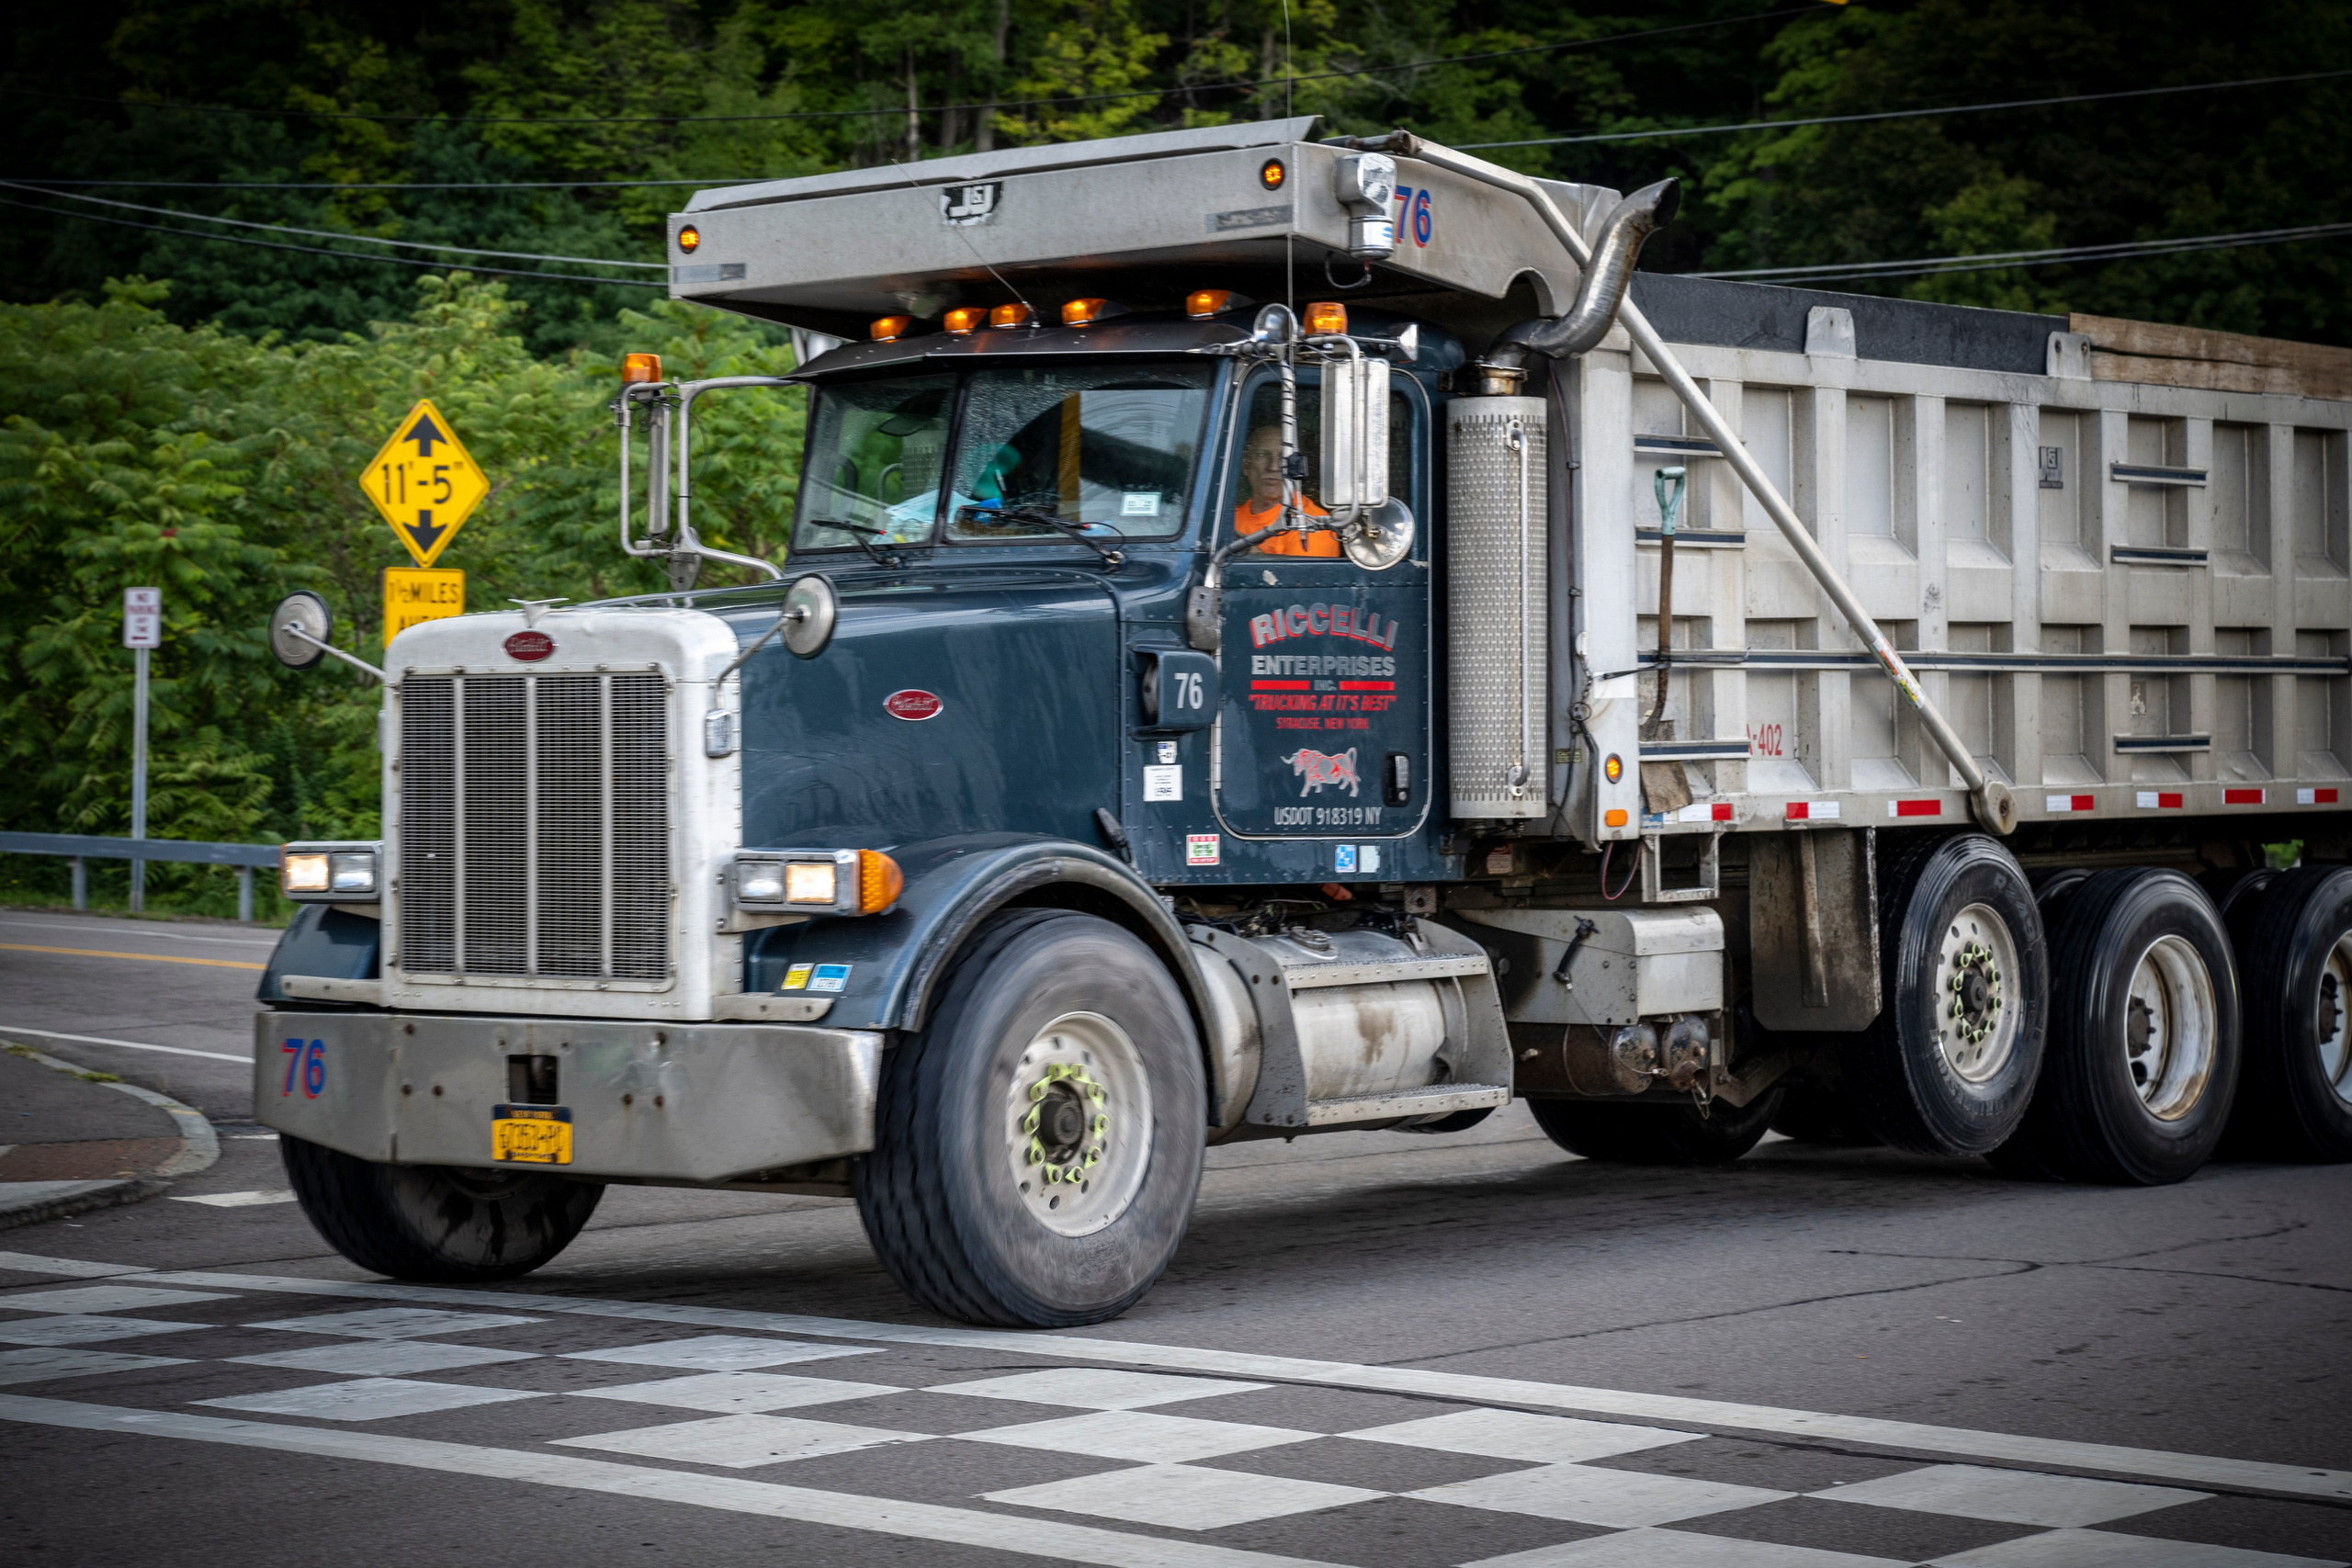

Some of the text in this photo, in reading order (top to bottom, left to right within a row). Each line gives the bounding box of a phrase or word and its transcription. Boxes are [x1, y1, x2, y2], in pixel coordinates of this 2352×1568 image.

[1394, 185, 1432, 248] 76
[411, 582, 459, 604] MILES
[1250, 602, 1399, 652] RICCELLI
[1251, 655, 1396, 676] ENTERPRISES
[1174, 672, 1204, 709] 76
[1318, 695, 1336, 711] AT
[1324, 717, 1343, 729] NEW
[1345, 718, 1369, 729] YORK
[1274, 807, 1382, 825] USDOT 918319 NY
[280, 1038, 326, 1100] 76
